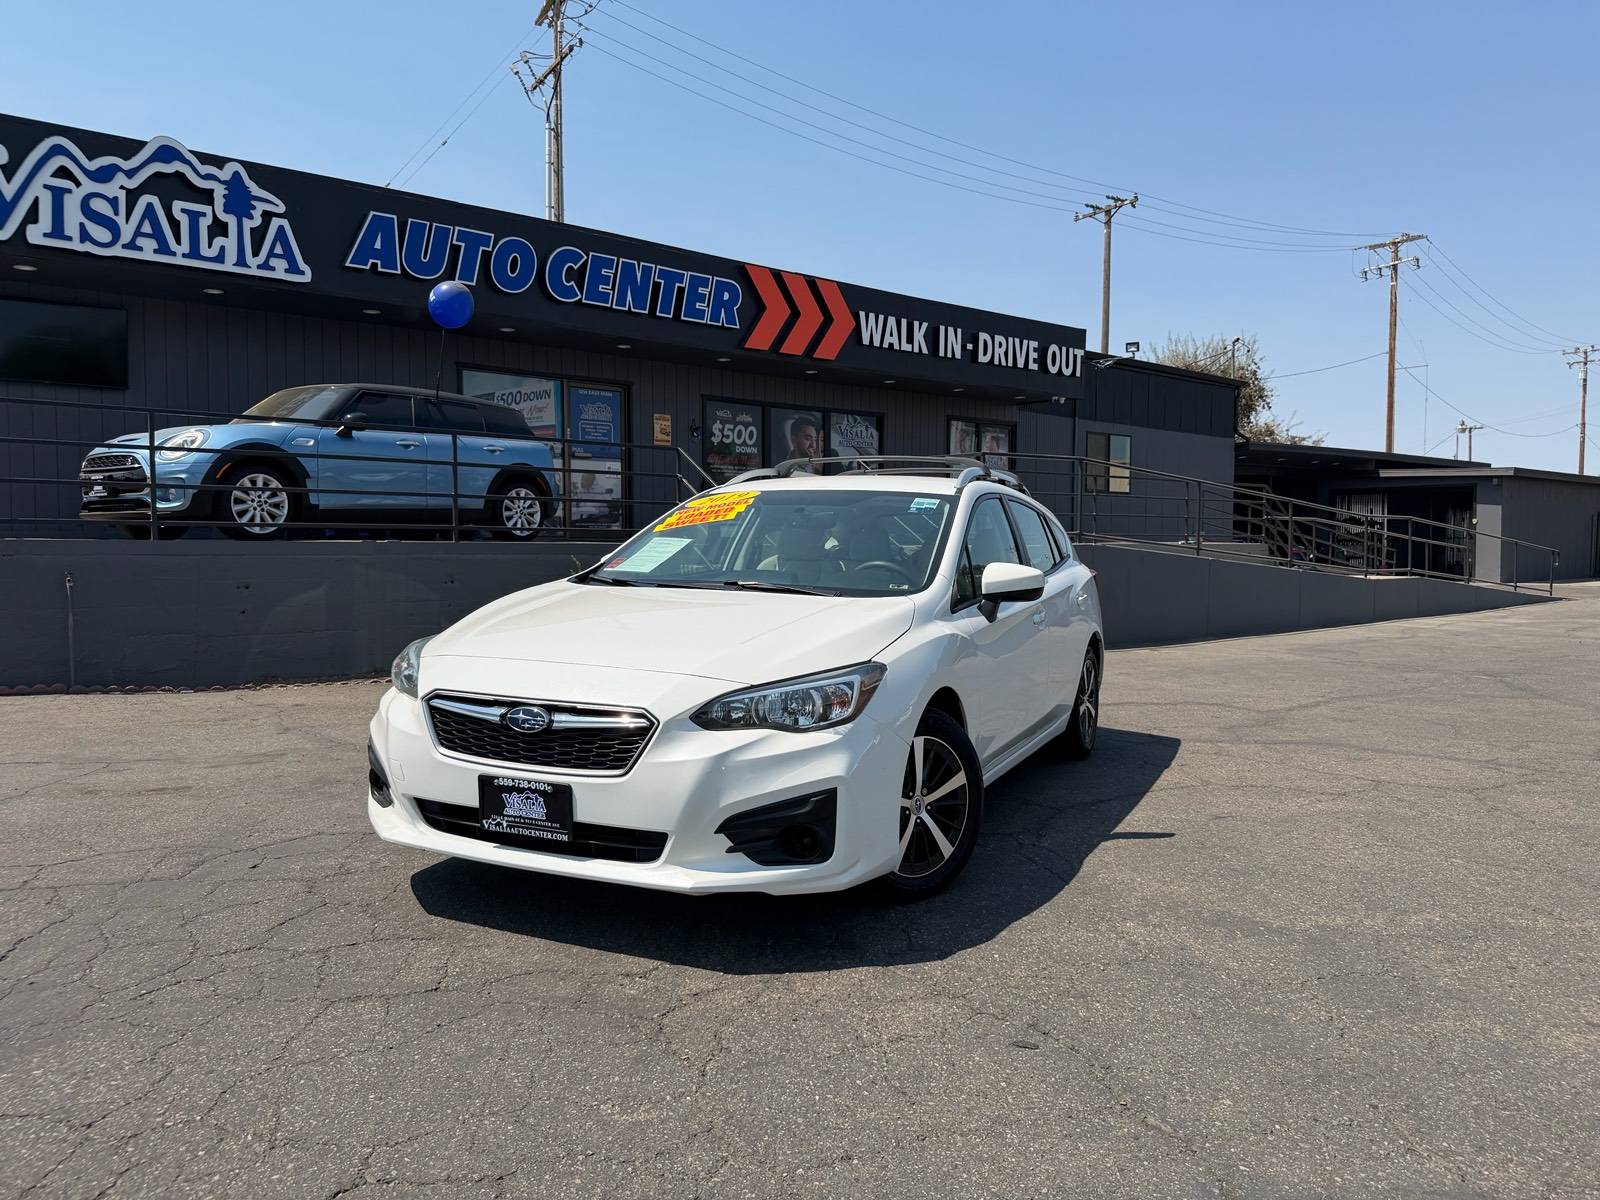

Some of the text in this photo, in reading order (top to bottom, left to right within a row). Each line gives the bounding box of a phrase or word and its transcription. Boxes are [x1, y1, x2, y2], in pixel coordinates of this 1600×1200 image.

[345, 211, 742, 329] AUTO CENTER
[858, 310, 929, 355] WALK
[1046, 343, 1085, 378] OUT
[523, 388, 552, 402] DOWN
[711, 420, 758, 446] $500
[838, 423, 874, 440] VISALIA
[735, 445, 758, 454] DOWN
[675, 506, 736, 522] LOADED
[676, 498, 749, 516] NEW MODEL
[498, 777, 548, 790] 559-738-0101
[502, 791, 547, 813] VISALIA
[482, 819, 568, 841] VISALIAAUTOCENTER.COM
